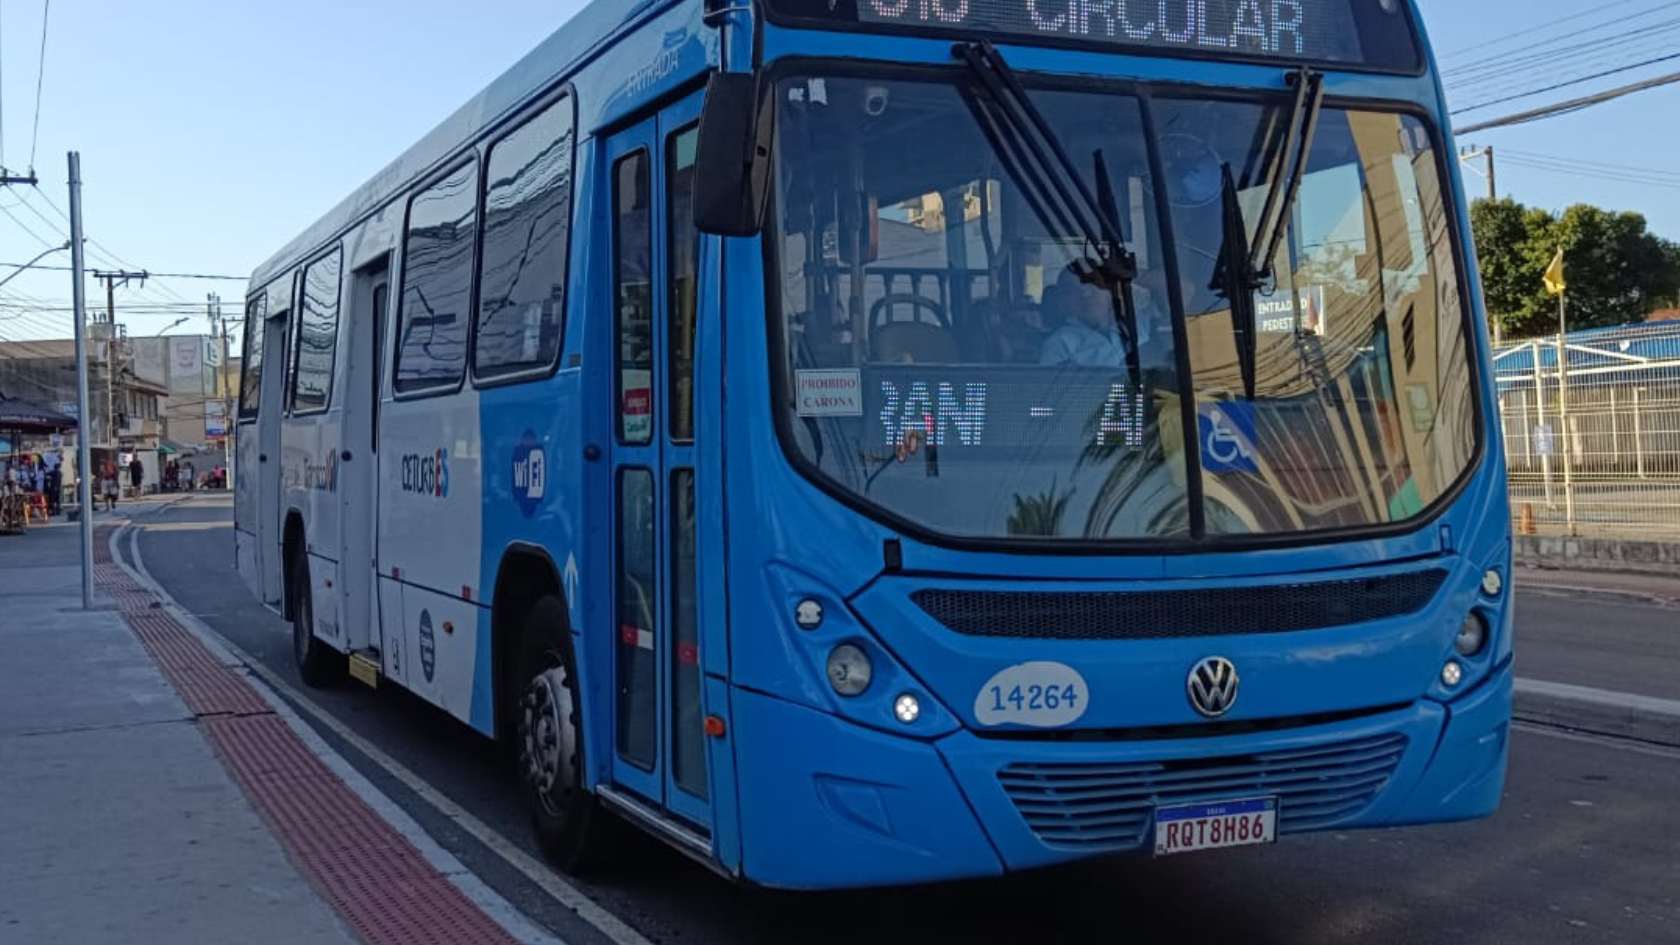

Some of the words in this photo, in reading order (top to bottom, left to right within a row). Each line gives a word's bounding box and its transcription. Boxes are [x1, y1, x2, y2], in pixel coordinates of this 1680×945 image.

[1026, 0, 1303, 53] CIRCULAR
[800, 377, 856, 390] PROIBIDO
[803, 397, 854, 409] CARONA
[990, 684, 1077, 711] 14264
[1166, 814, 1264, 849] RQT8H86
